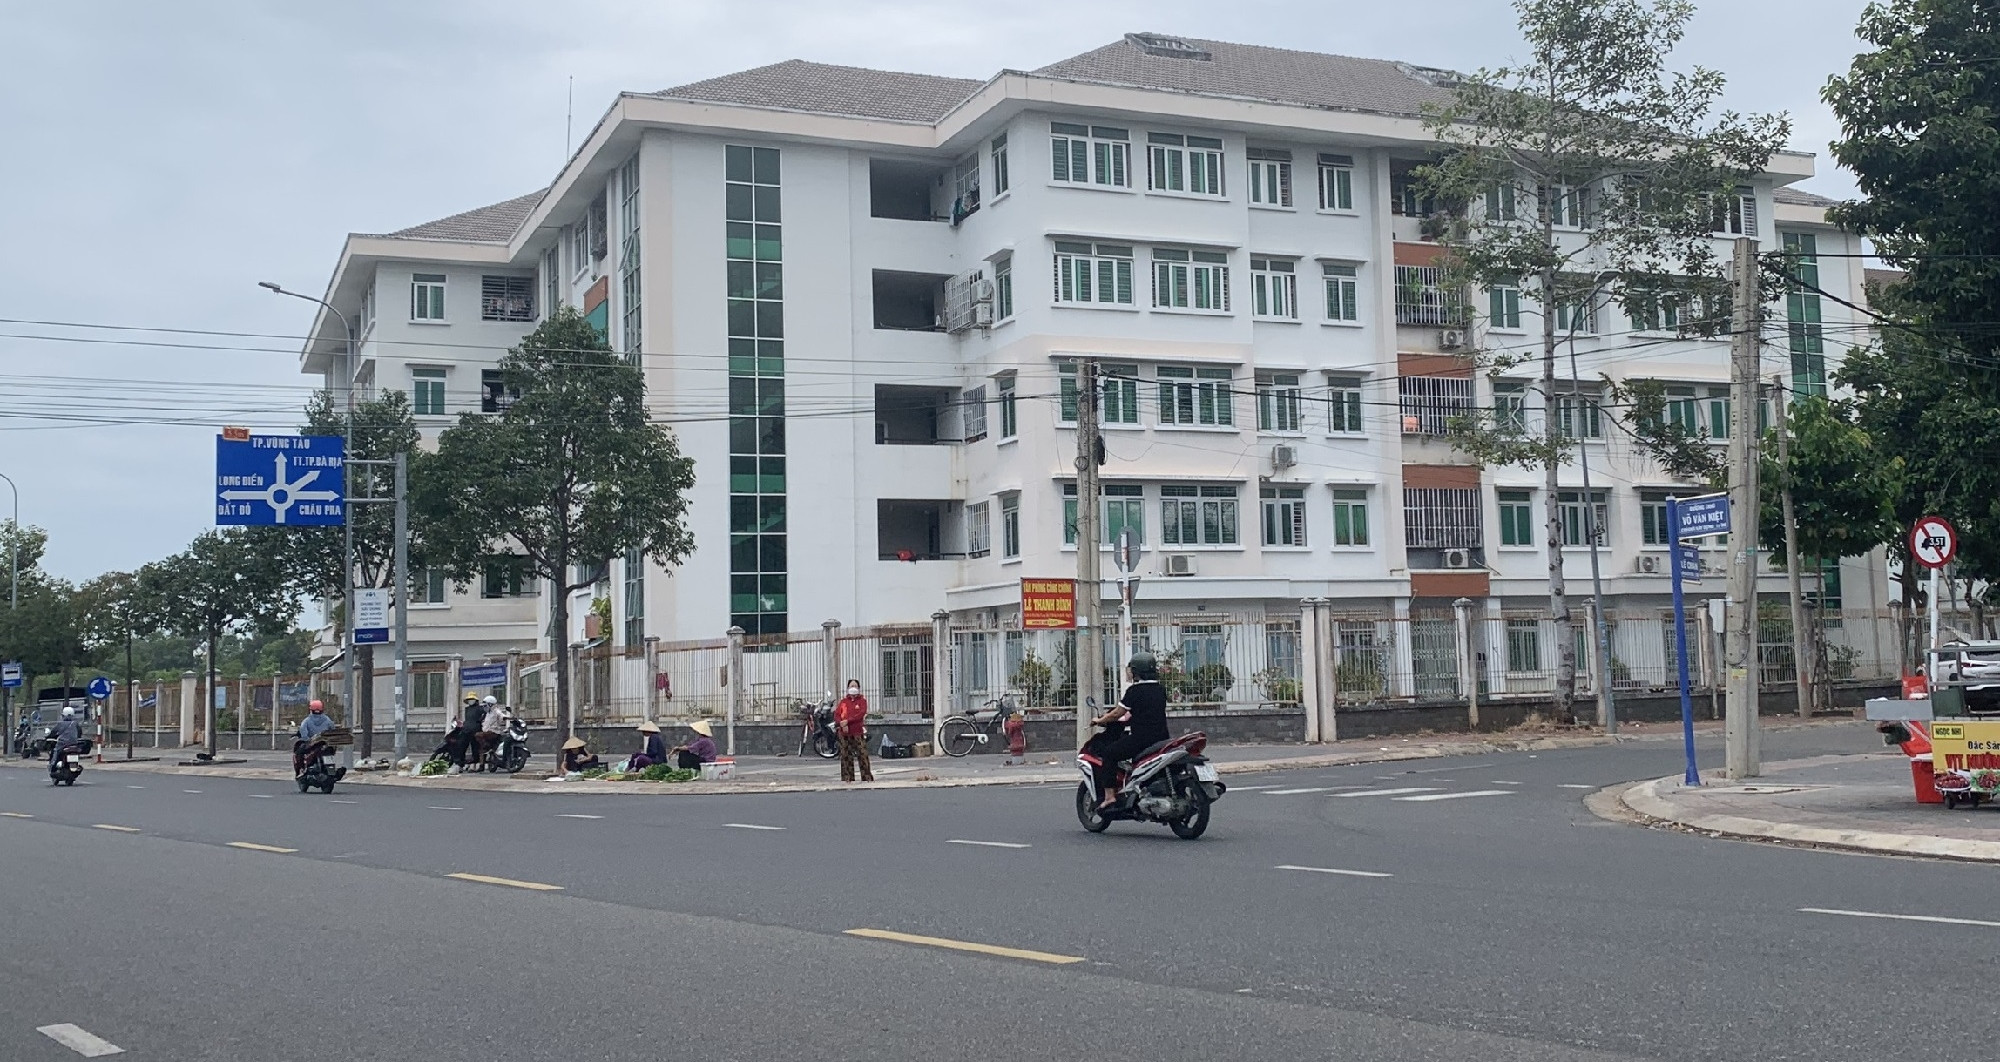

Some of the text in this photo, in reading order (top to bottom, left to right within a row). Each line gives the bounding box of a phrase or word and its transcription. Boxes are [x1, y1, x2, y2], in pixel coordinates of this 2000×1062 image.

[293, 438, 310, 449] TÀU
[218, 476, 240, 486] LONG
[218, 502, 251, 515] ĐẤT ĐỎ
[299, 503, 341, 515] CHÂU PHA
[1692, 512, 1707, 524] VĂN
[1707, 510, 1724, 523] KIỆT
[1032, 598, 1055, 611] THANH
